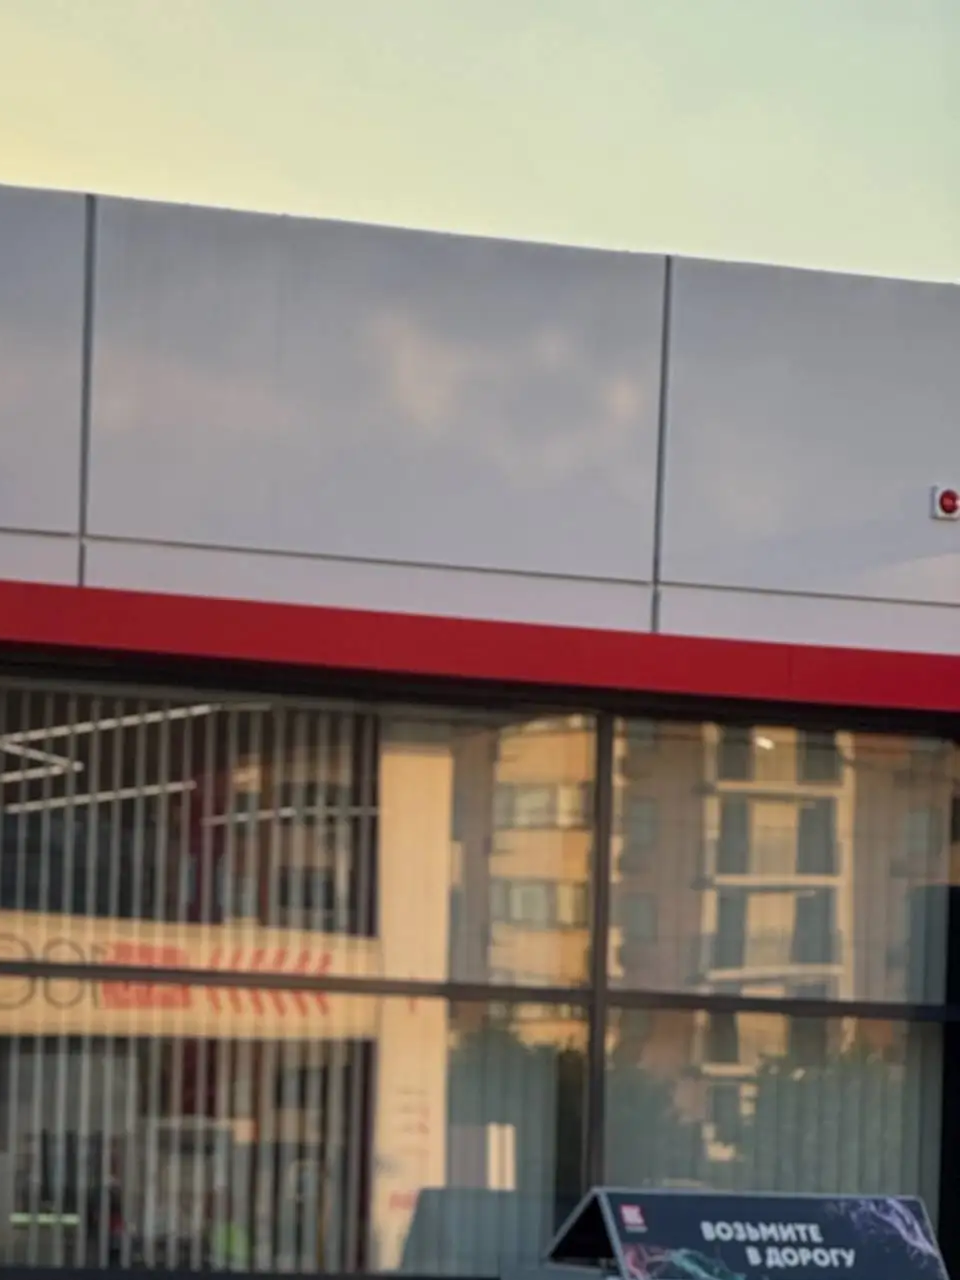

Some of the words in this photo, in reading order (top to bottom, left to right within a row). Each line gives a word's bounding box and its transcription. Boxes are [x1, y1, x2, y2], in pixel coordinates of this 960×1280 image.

[700, 1220, 824, 1243] ВОЗЬМИТЕ
[745, 1246, 763, 1266] В
[764, 1246, 856, 1269] ДОРОГУ
